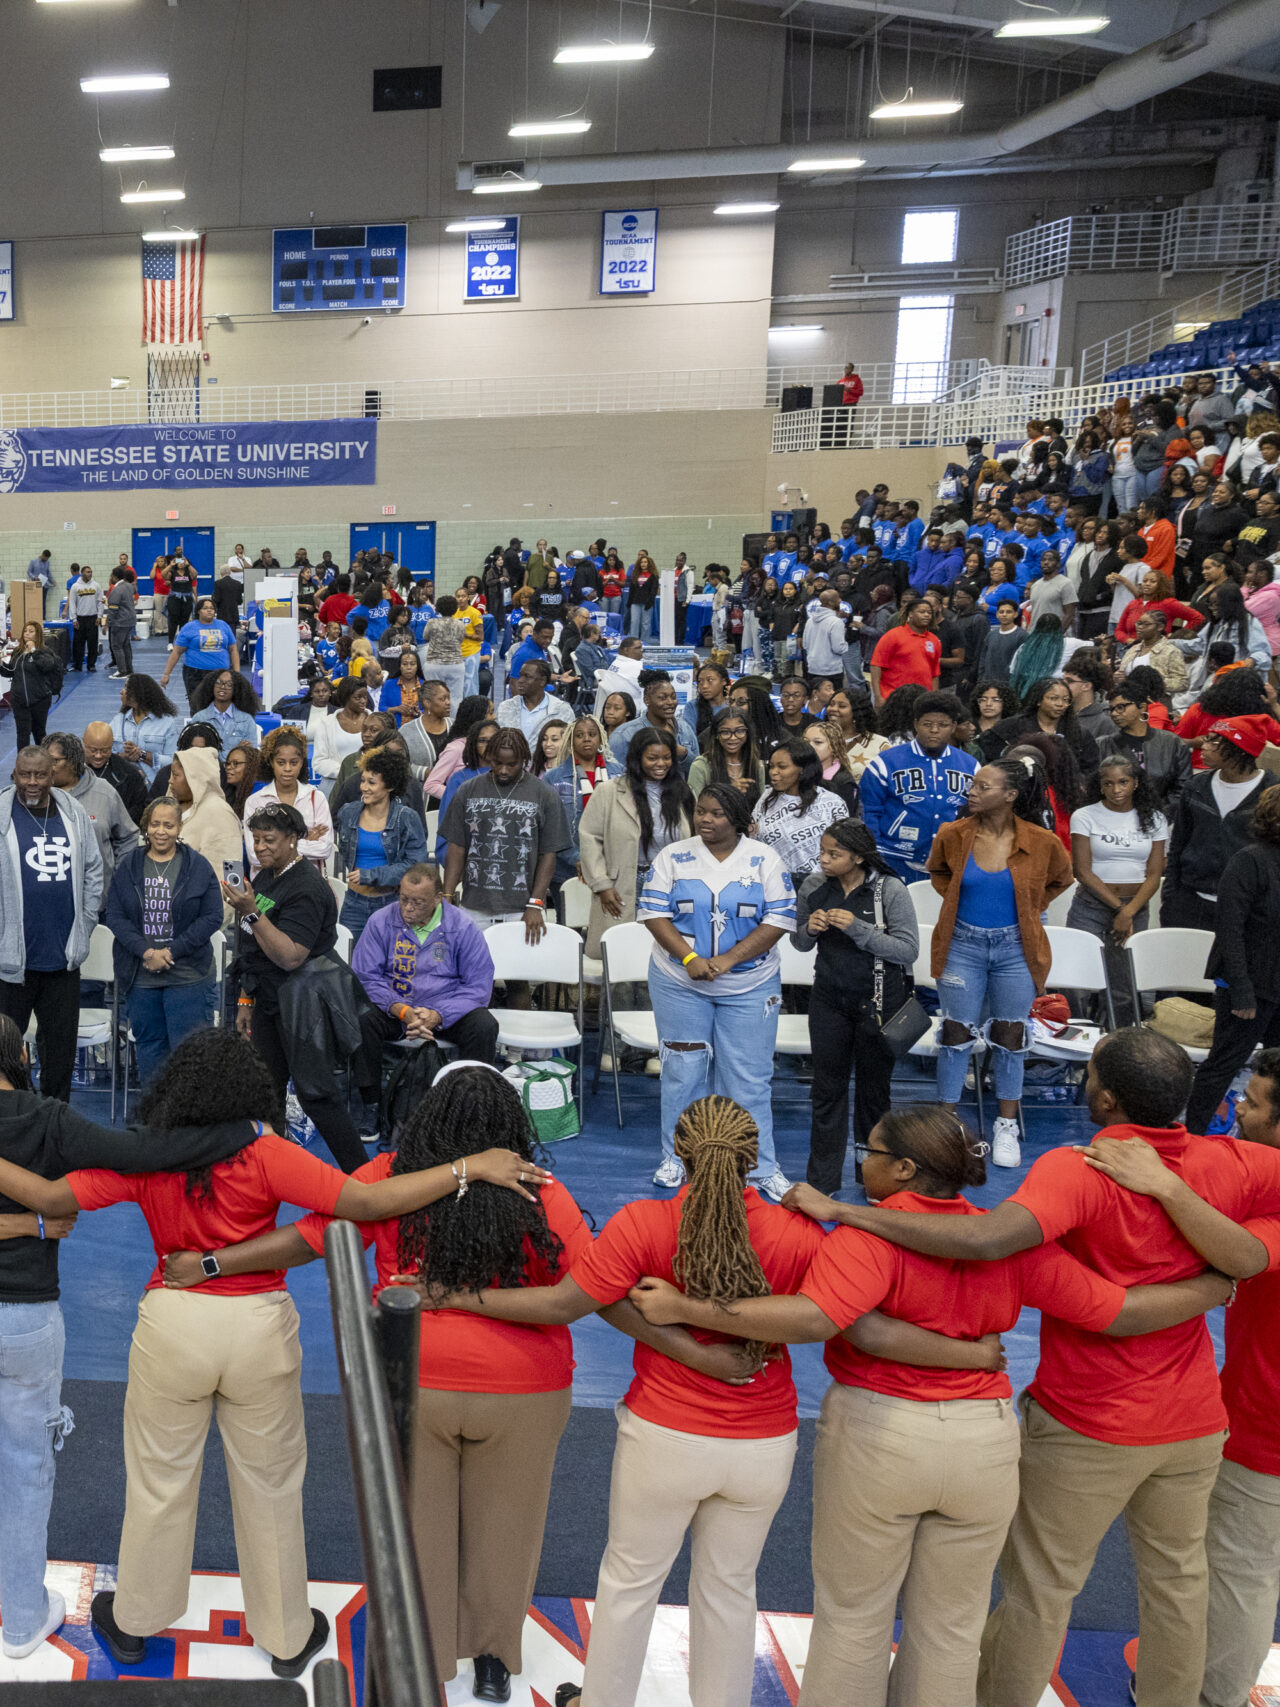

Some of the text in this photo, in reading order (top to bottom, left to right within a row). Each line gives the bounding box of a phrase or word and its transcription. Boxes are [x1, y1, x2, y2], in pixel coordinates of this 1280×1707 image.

[284, 247, 397, 260] HOME GUEST
[469, 243, 516, 252] CHAMPIONS
[471, 265, 512, 281] 2022
[609, 260, 648, 274] 2022
[154, 429, 236, 441] WELCOME TO
[28, 441, 369, 467] TENNESSEE STATE UNIVERSITY
[81, 466, 310, 483] THE LAND OF GOLDEN SUNSHINE
[383, 506, 395, 514] EXIT
[144, 877, 170, 887] DO A
[145, 887, 172, 899] ITTL
[144, 911, 169, 923] EVER
